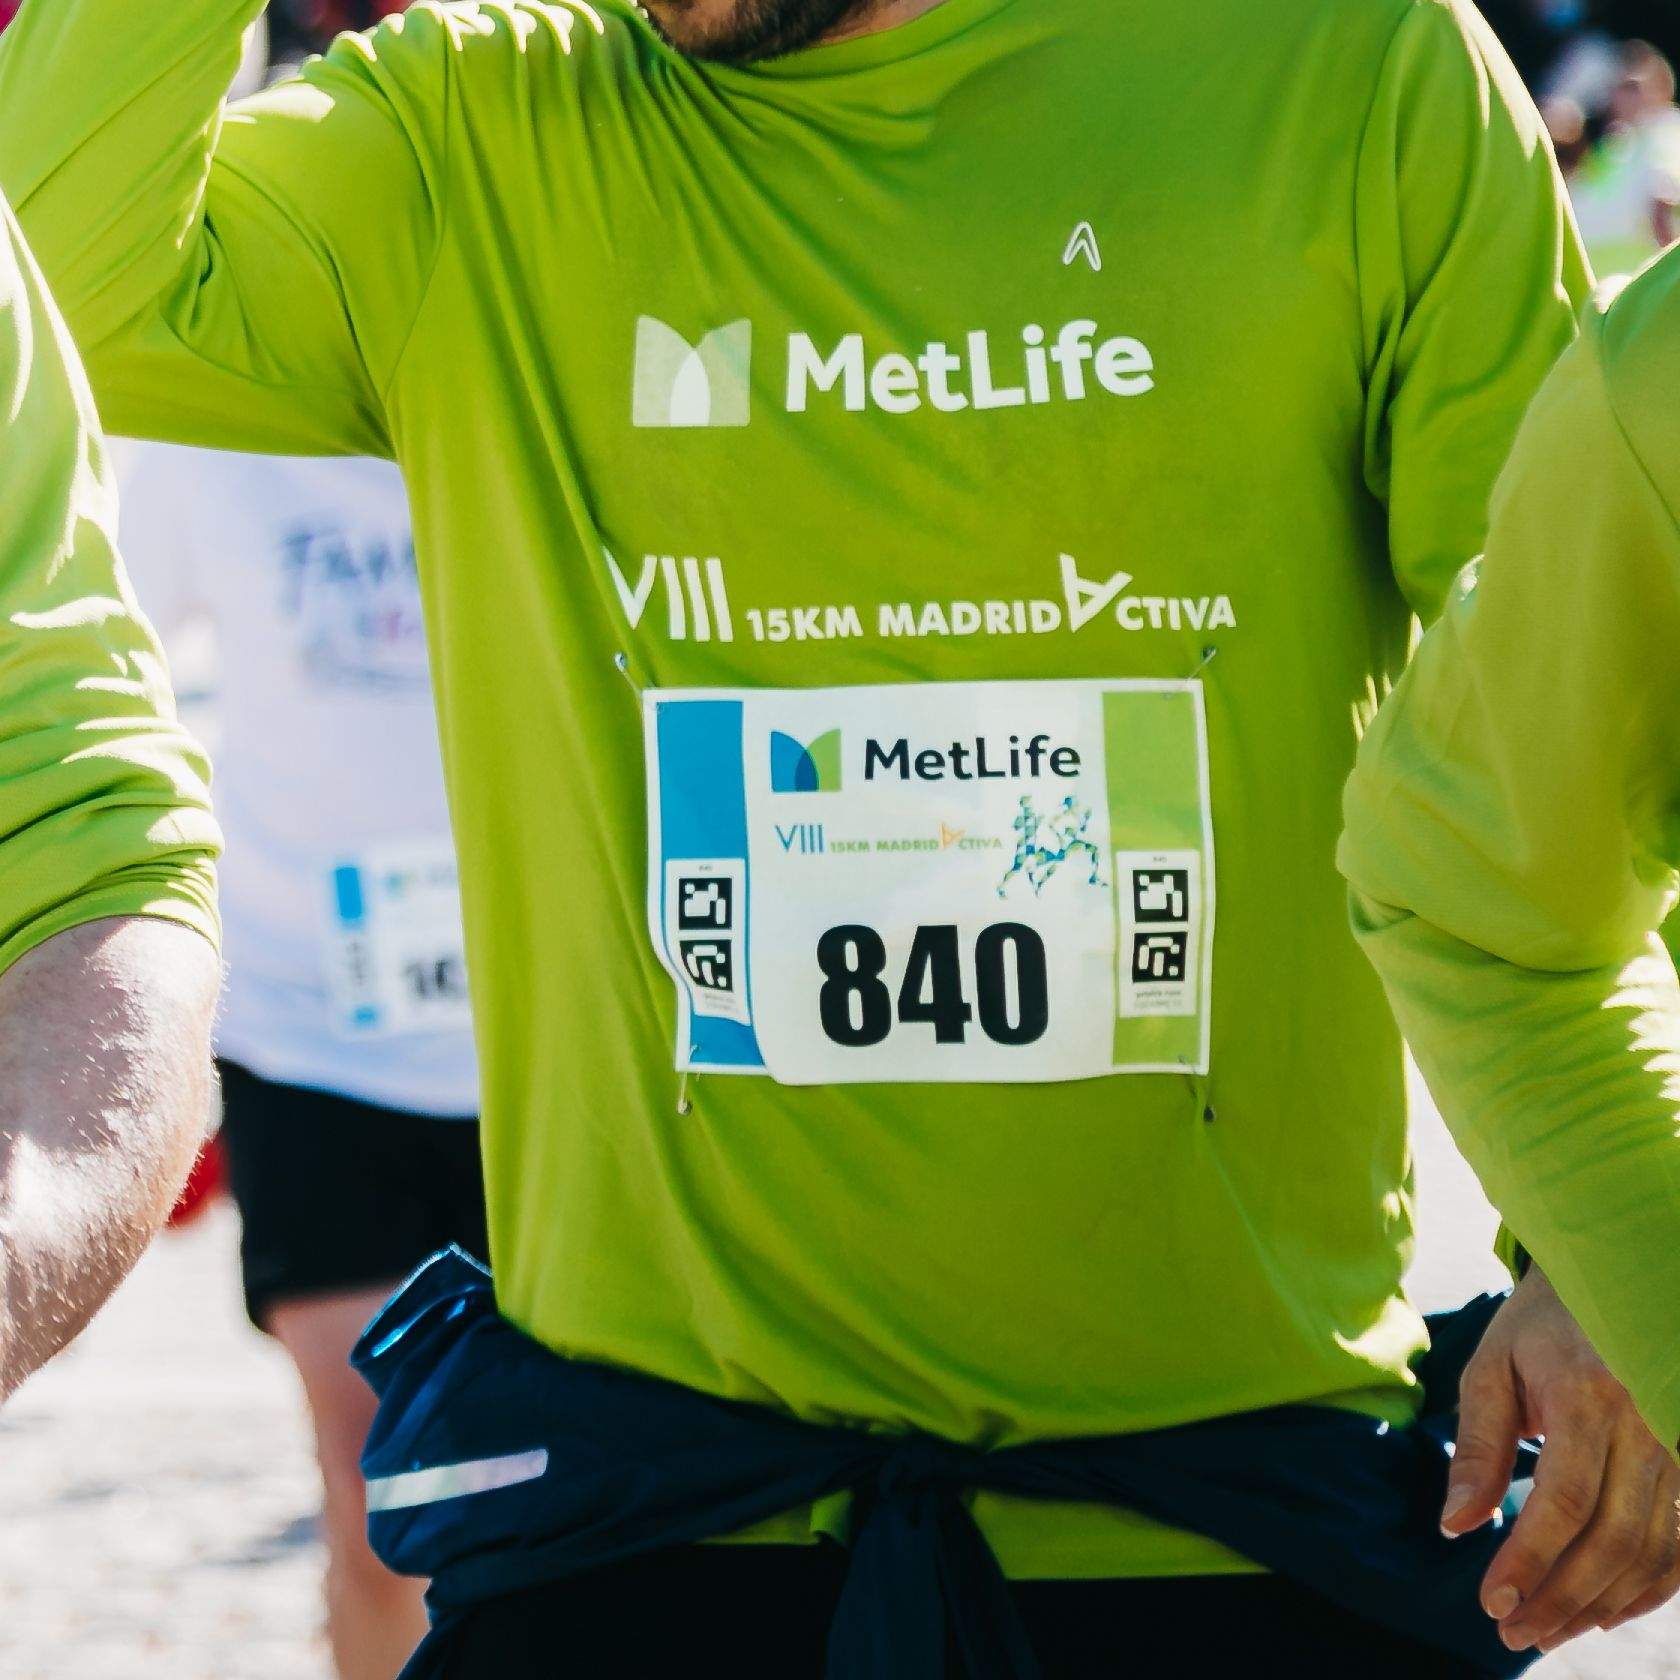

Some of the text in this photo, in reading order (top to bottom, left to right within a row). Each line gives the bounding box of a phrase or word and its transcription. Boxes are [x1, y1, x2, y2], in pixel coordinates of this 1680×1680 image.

[786, 319, 1155, 415] MetLife
[601, 545, 734, 642] VIII
[746, 603, 864, 642] 15KM
[877, 597, 1061, 639] MADRID
[863, 734, 1081, 782] MetLife
[774, 823, 825, 854] VIII
[829, 839, 871, 854] 15KM
[876, 838, 940, 853] MADRID
[815, 921, 1050, 1048] 840
